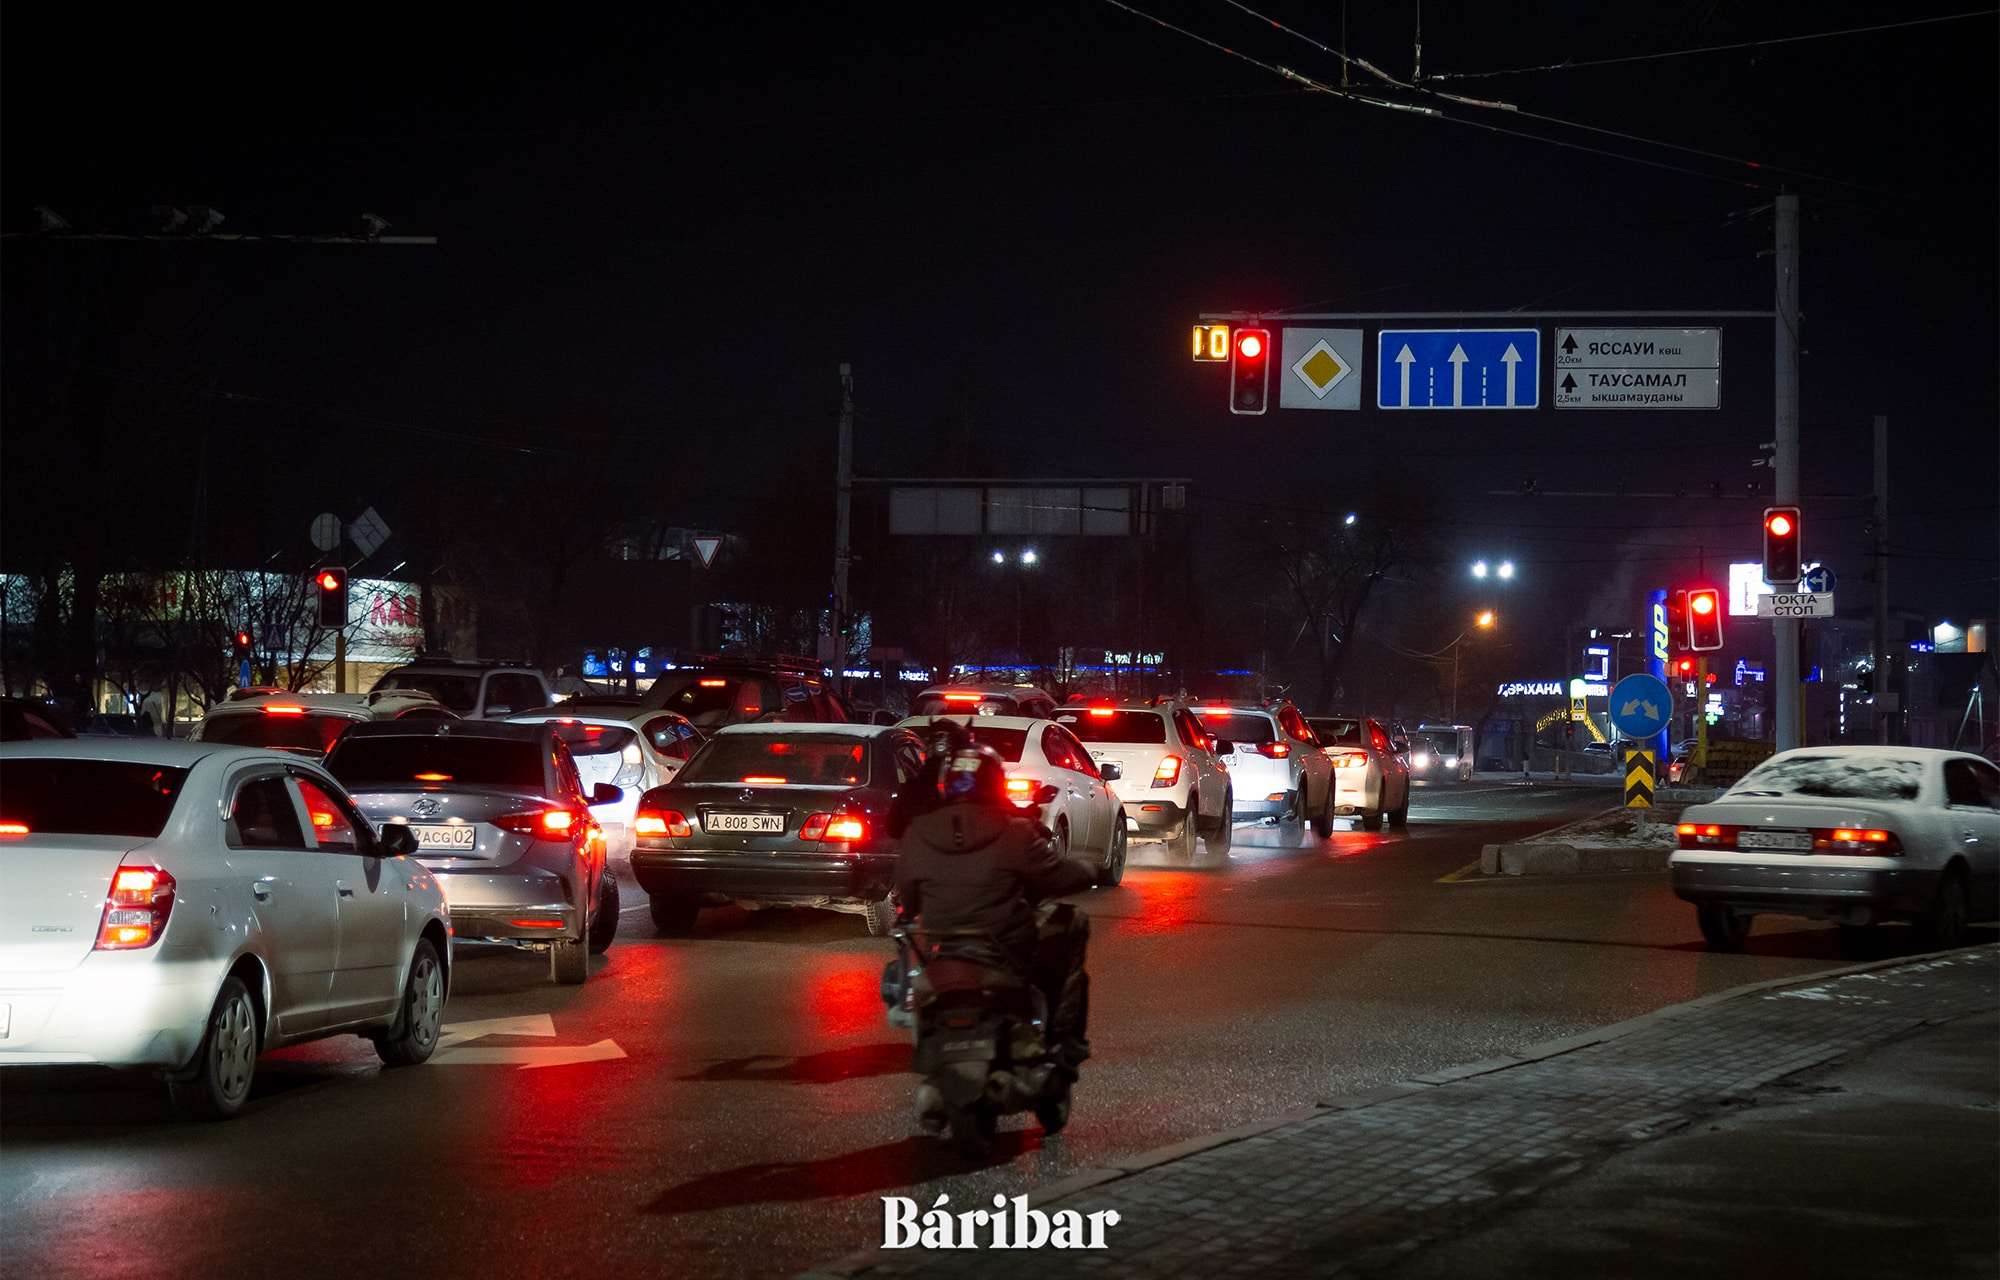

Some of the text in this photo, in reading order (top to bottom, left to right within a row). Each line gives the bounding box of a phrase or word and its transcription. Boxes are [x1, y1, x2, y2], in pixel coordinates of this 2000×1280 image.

[1195, 326, 1227, 358] 10
[1588, 342, 1654, 355] ЯССАУИ
[1588, 374, 1687, 387] ТАУСАМАЛ
[1774, 606, 1814, 616] СТОП
[712, 817, 780, 830] A 808 SWN
[454, 829, 473, 844] 02
